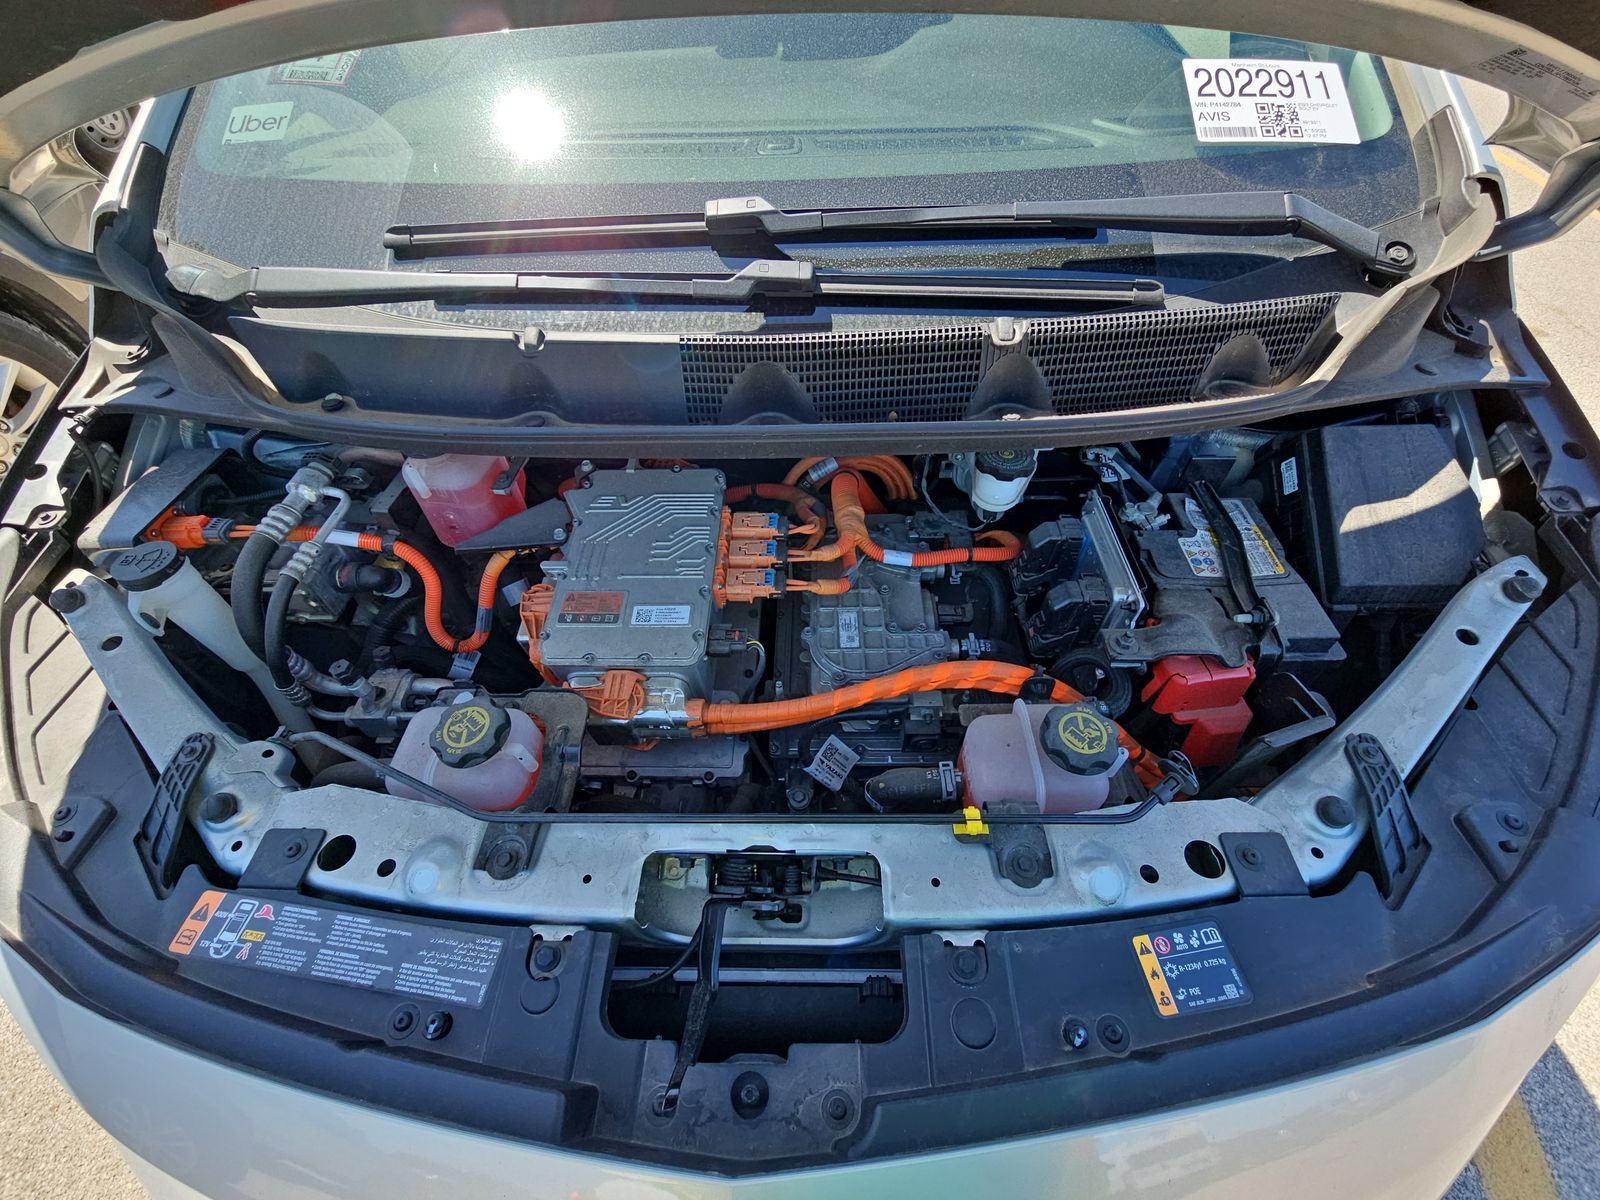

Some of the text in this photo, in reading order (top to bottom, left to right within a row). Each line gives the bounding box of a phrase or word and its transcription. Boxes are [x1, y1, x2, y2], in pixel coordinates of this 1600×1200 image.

[1194, 67, 1331, 100] 2022911
[1198, 111, 1231, 122] AVIS
[229, 114, 288, 134] Uber
[825, 763, 844, 780] YAZAKI
[1176, 943, 1189, 951] AUTO
[1204, 958, 1218, 968] 0.725
[1218, 957, 1227, 965] kg
[1189, 986, 1201, 996] POE
